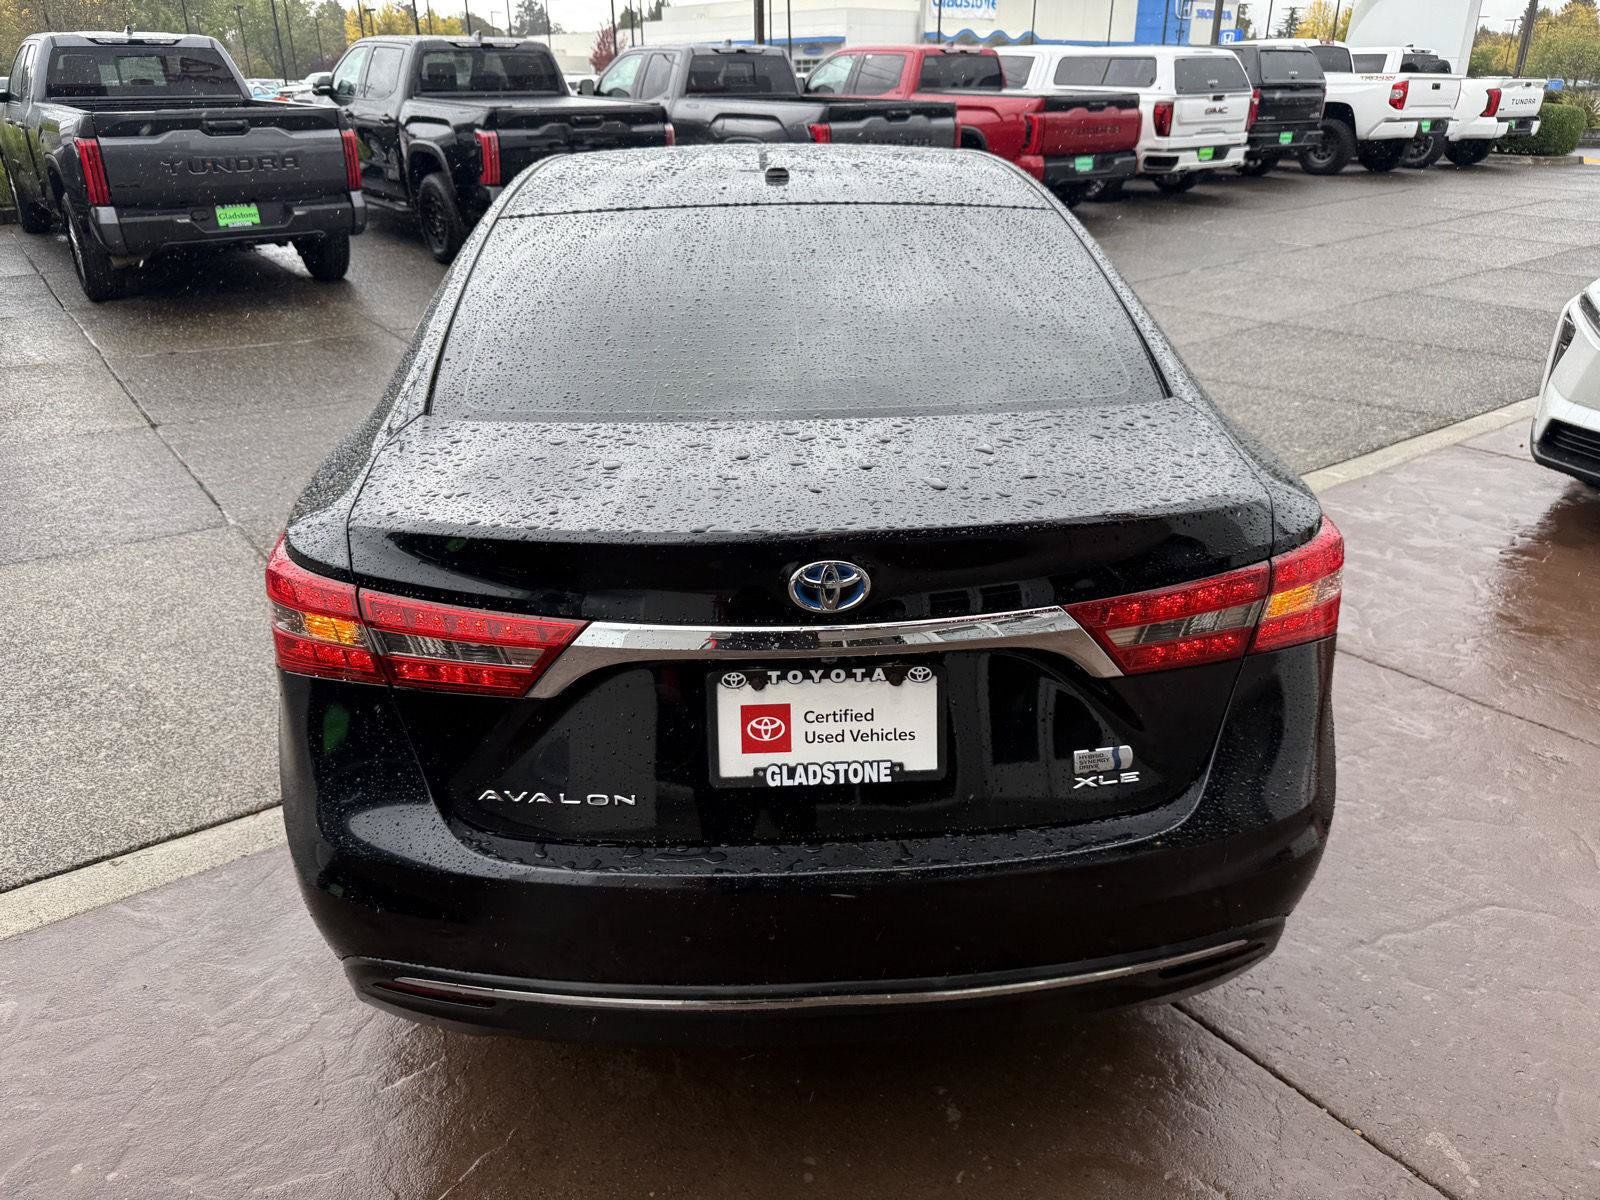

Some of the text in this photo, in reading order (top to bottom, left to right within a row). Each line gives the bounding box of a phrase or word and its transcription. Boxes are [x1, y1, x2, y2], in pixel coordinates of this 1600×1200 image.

[1204, 106, 1229, 115] GMC
[160, 157, 300, 176] TUNDRA
[218, 211, 258, 220] Gladstone
[767, 668, 886, 684] TOYOTA
[803, 708, 875, 724] Certified
[804, 728, 916, 744] Used Vehicles
[766, 761, 892, 787] GLADSTONE
[1073, 771, 1140, 789] XLE
[478, 789, 636, 806] AVALON
